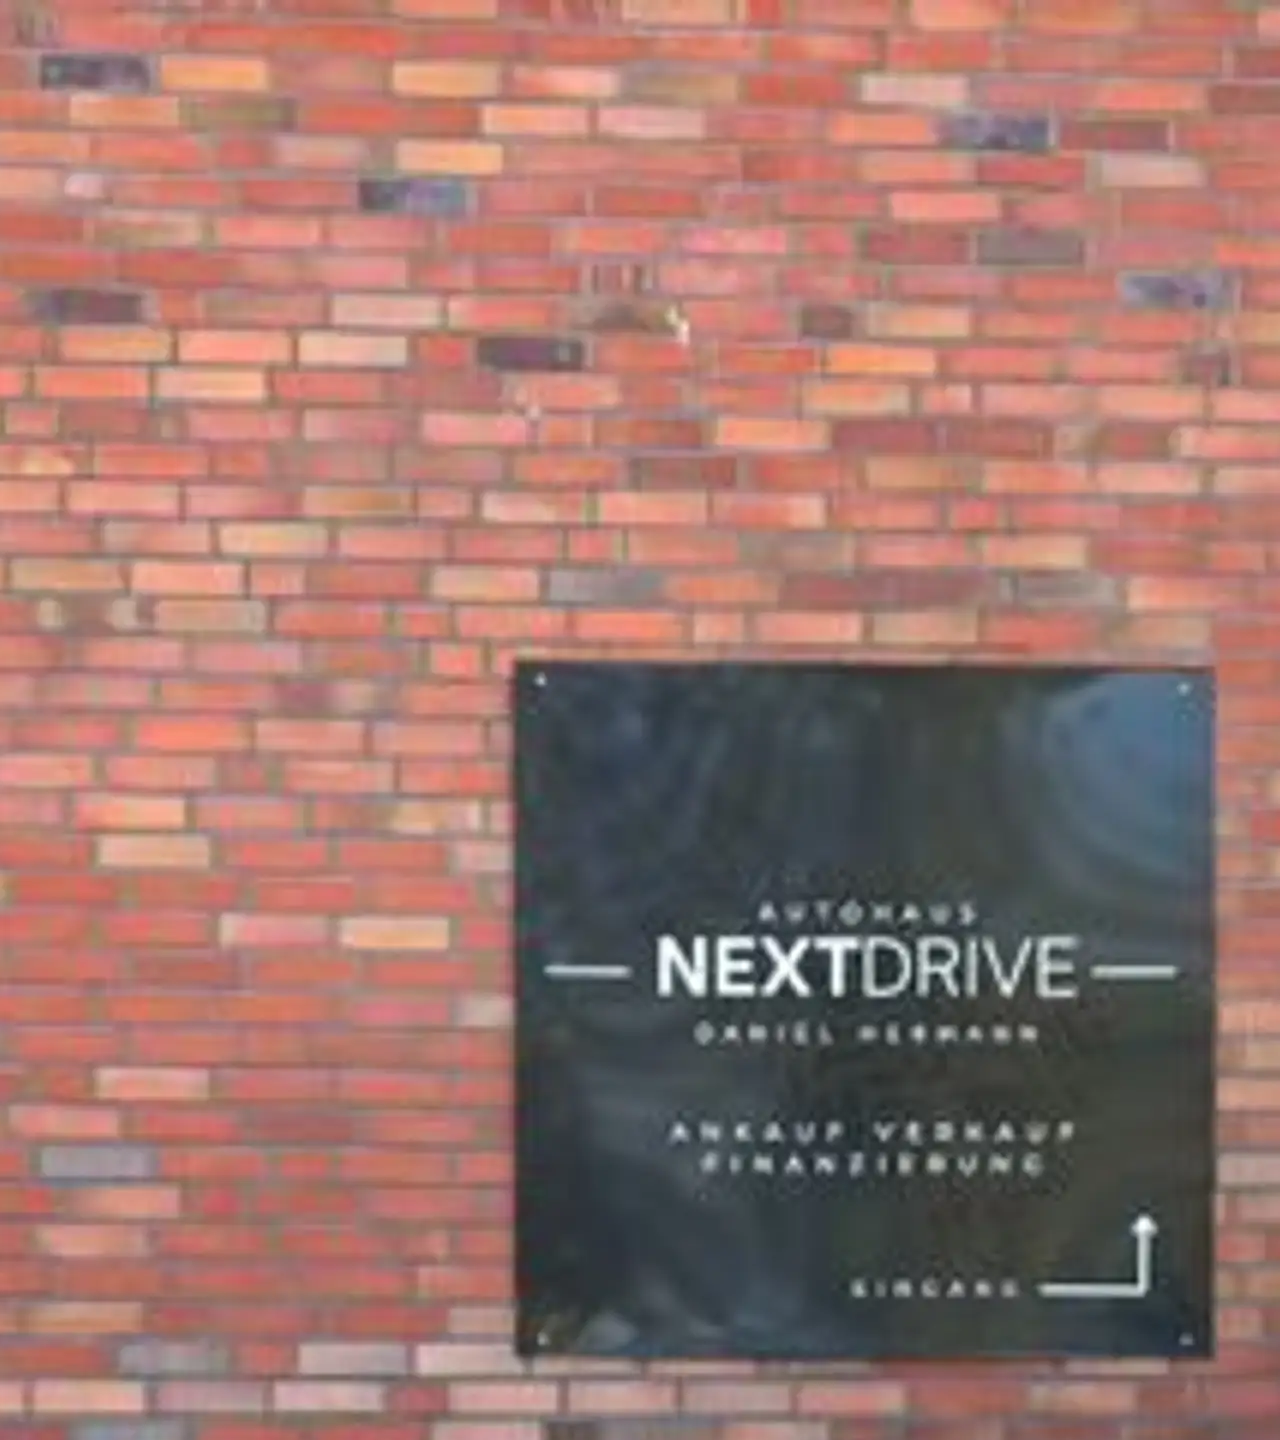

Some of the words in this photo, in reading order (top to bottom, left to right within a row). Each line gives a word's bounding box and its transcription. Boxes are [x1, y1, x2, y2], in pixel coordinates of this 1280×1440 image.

[757, 901, 978, 926] AUTOHAUS
[656, 935, 1078, 999] NEXTDRIVE
[669, 1121, 844, 1143] ANKAUF
[874, 1121, 1075, 1144] VERKAUF
[699, 1151, 1042, 1176] FINANZIERUNG
